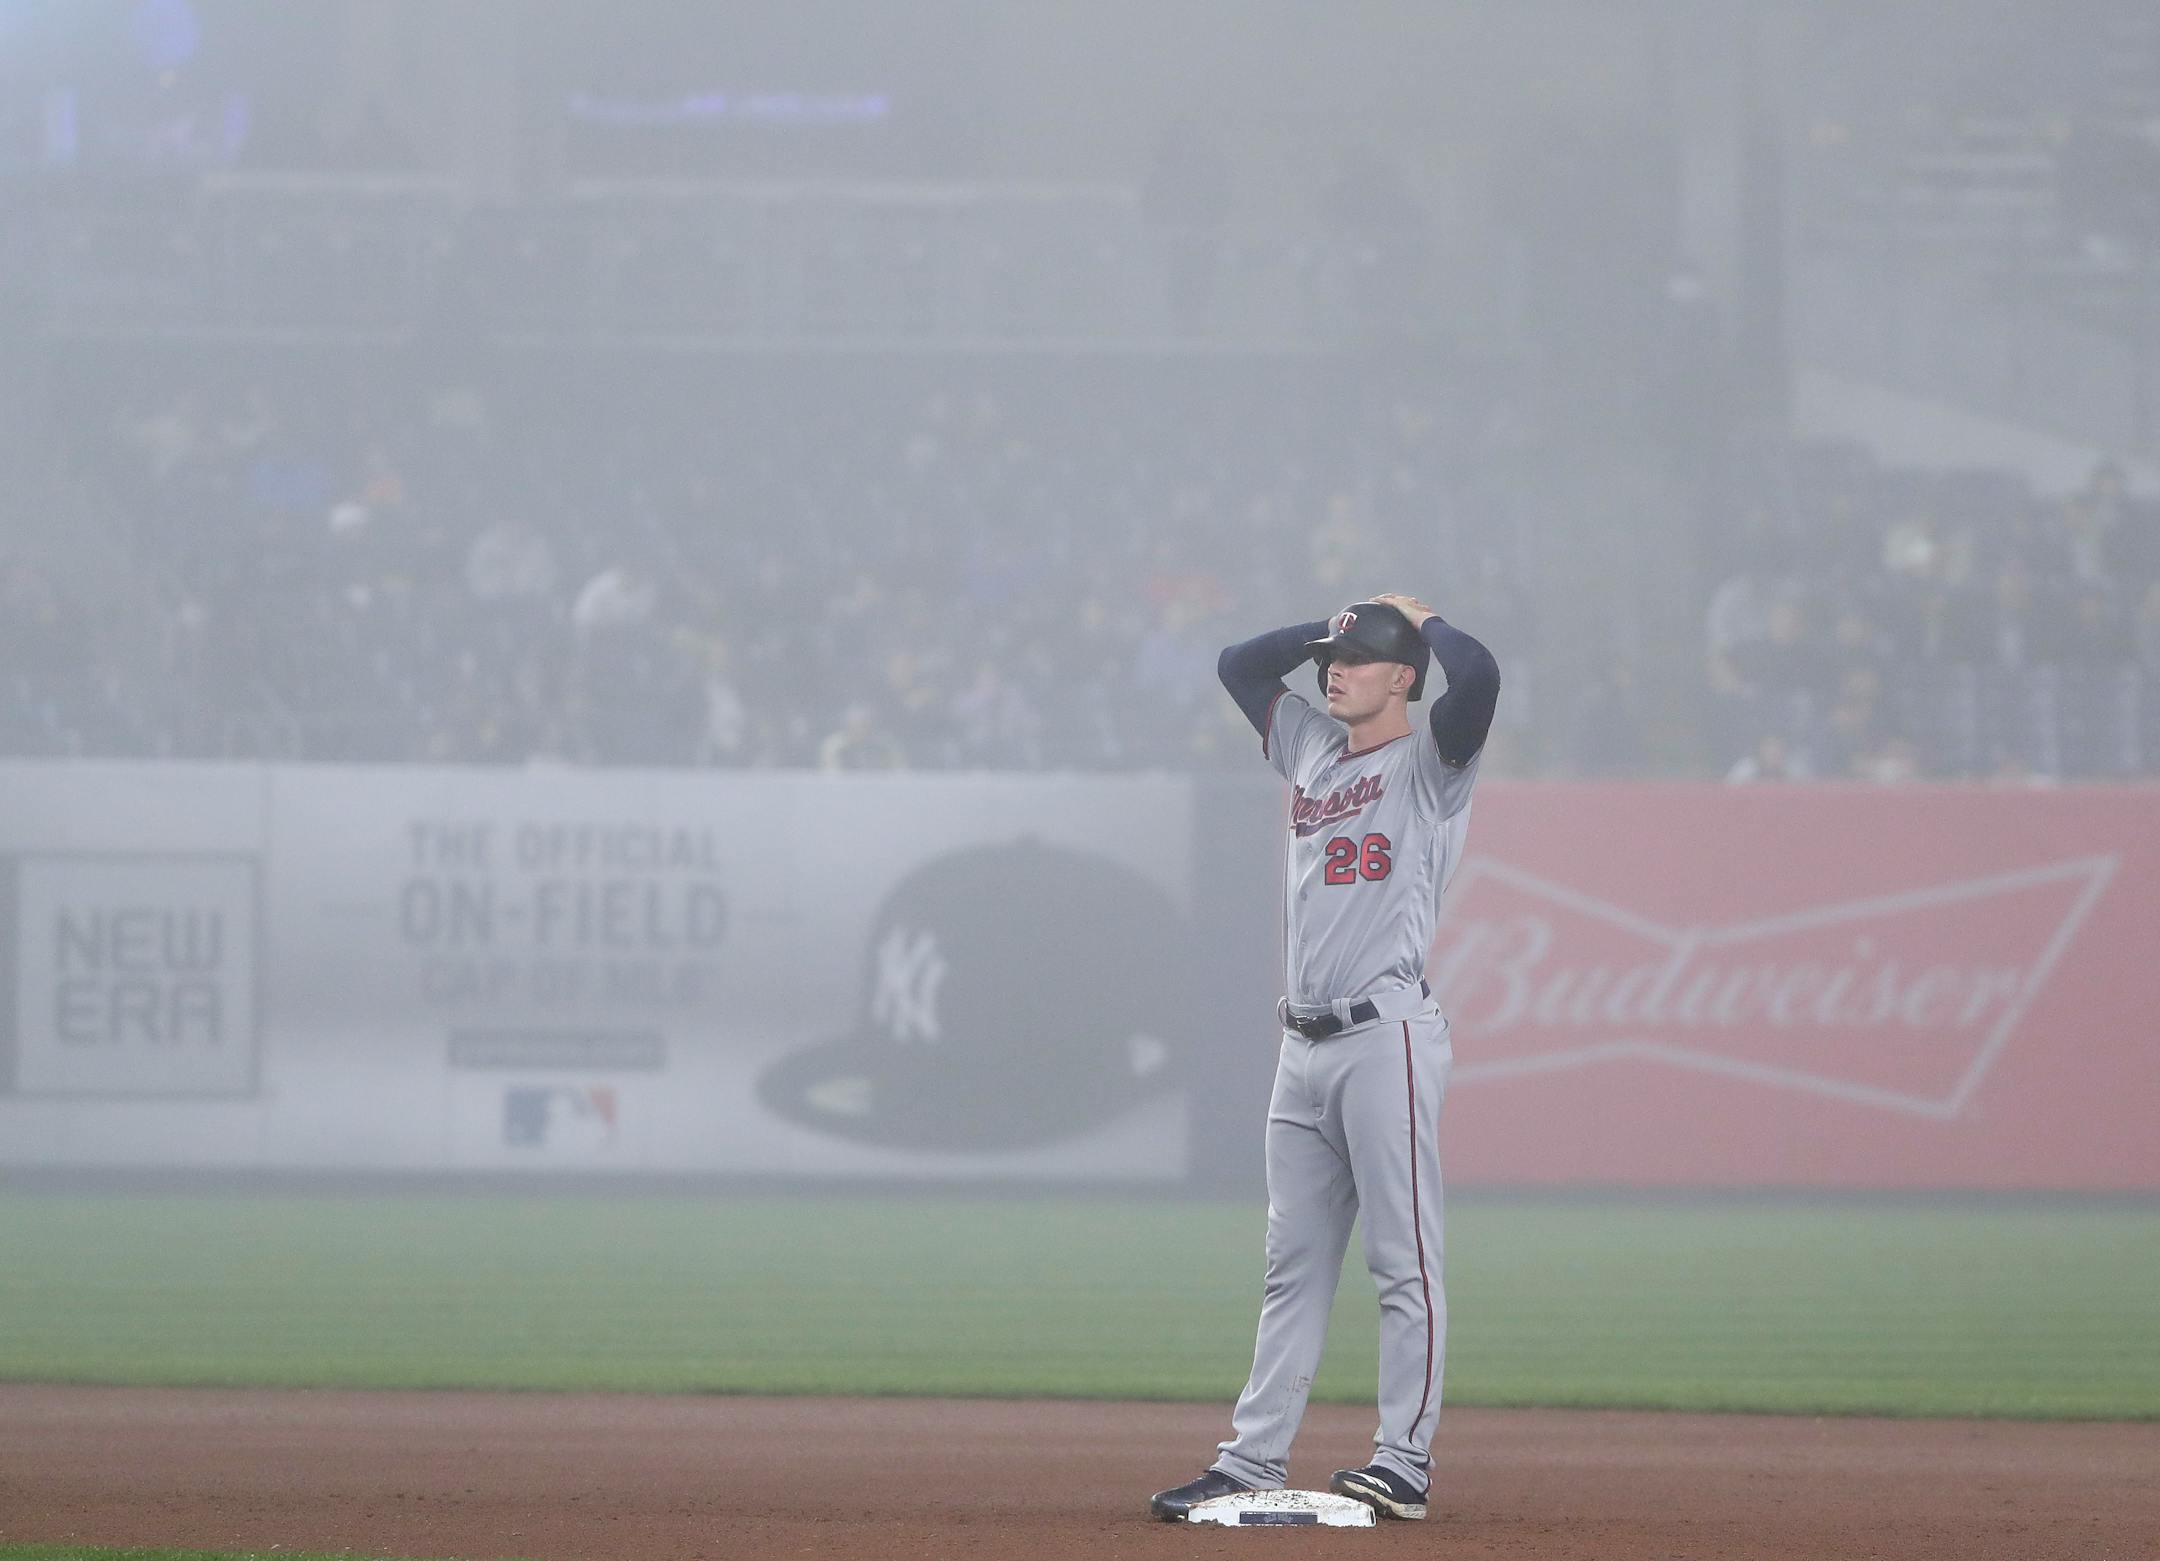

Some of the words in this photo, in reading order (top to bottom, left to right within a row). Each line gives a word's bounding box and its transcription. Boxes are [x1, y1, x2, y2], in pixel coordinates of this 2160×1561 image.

[408, 821, 494, 866] THE
[513, 823, 721, 873] OFFICIAL
[1324, 832, 1392, 886] 26
[56, 904, 223, 970] NEW
[399, 877, 729, 948] ON-FIELD
[1434, 915, 2020, 1036] Budweiser
[56, 976, 223, 1047] ERA
